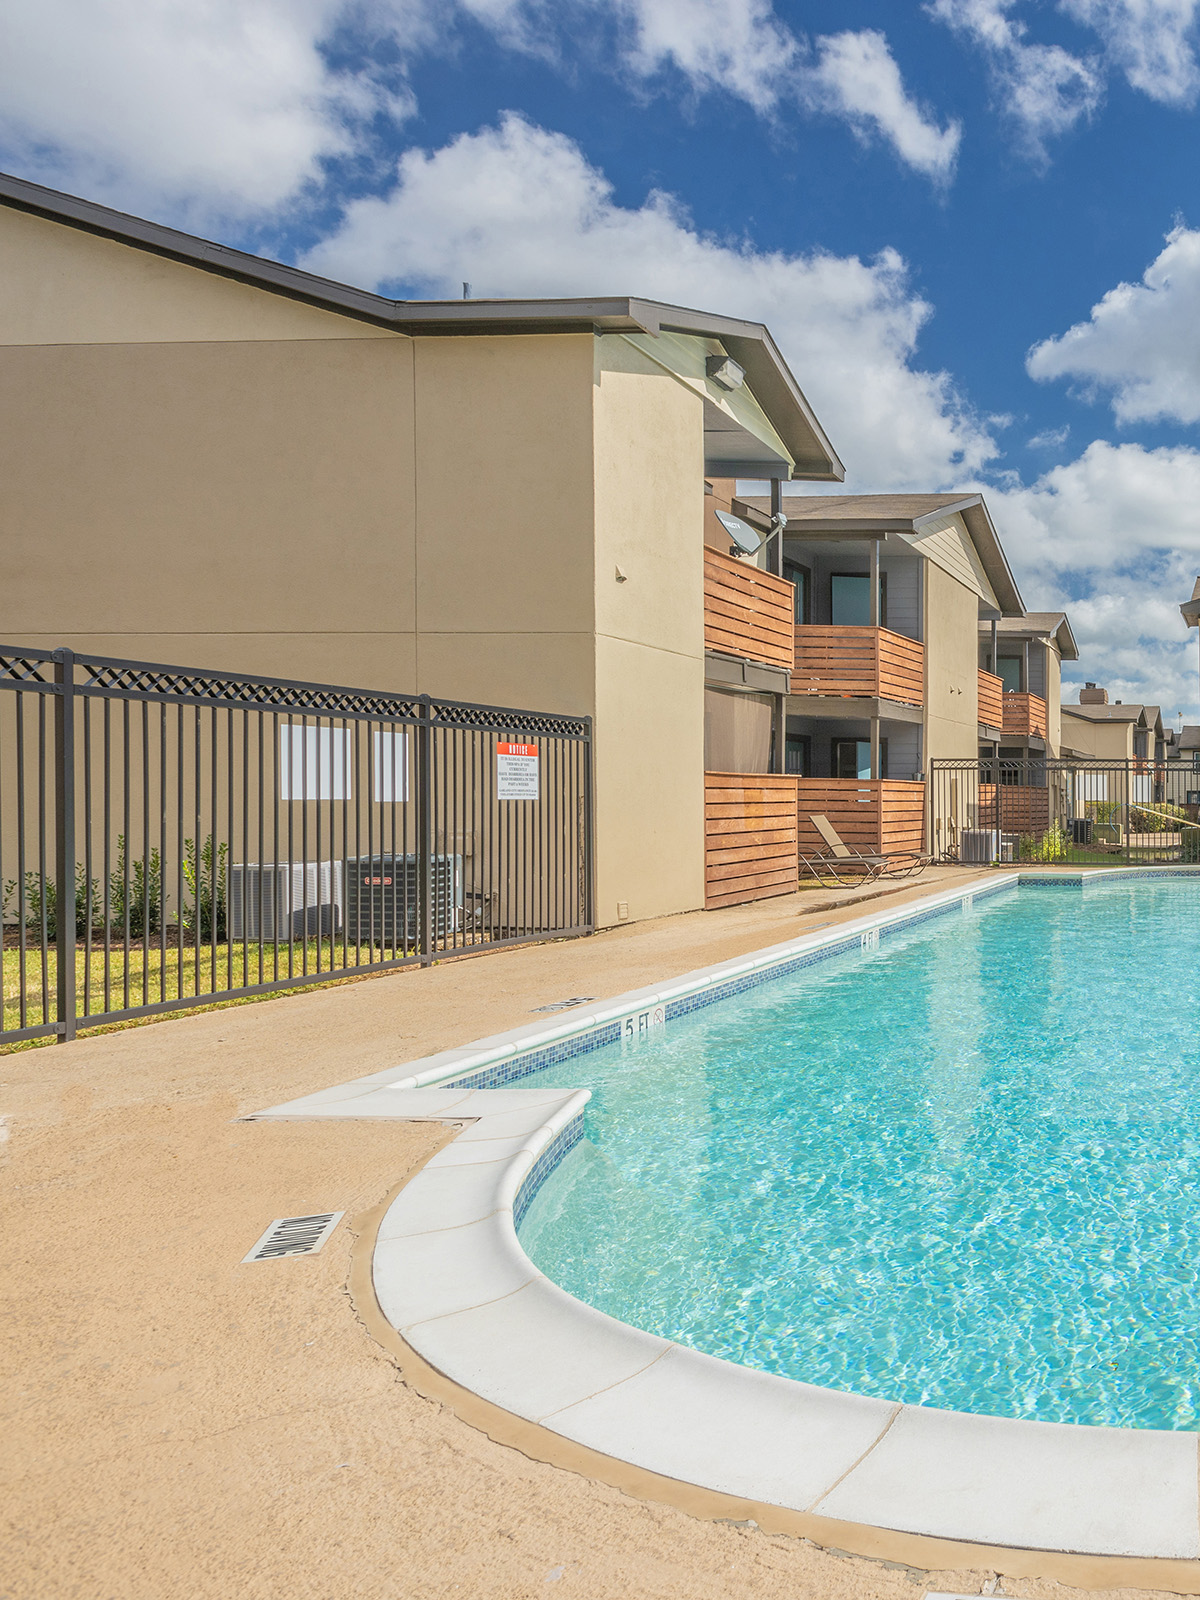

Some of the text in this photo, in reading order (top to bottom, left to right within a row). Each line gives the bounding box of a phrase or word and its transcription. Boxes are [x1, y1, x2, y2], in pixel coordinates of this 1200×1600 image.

[508, 744, 528, 755] NOTICE
[626, 1012, 650, 1036] 5 FT
